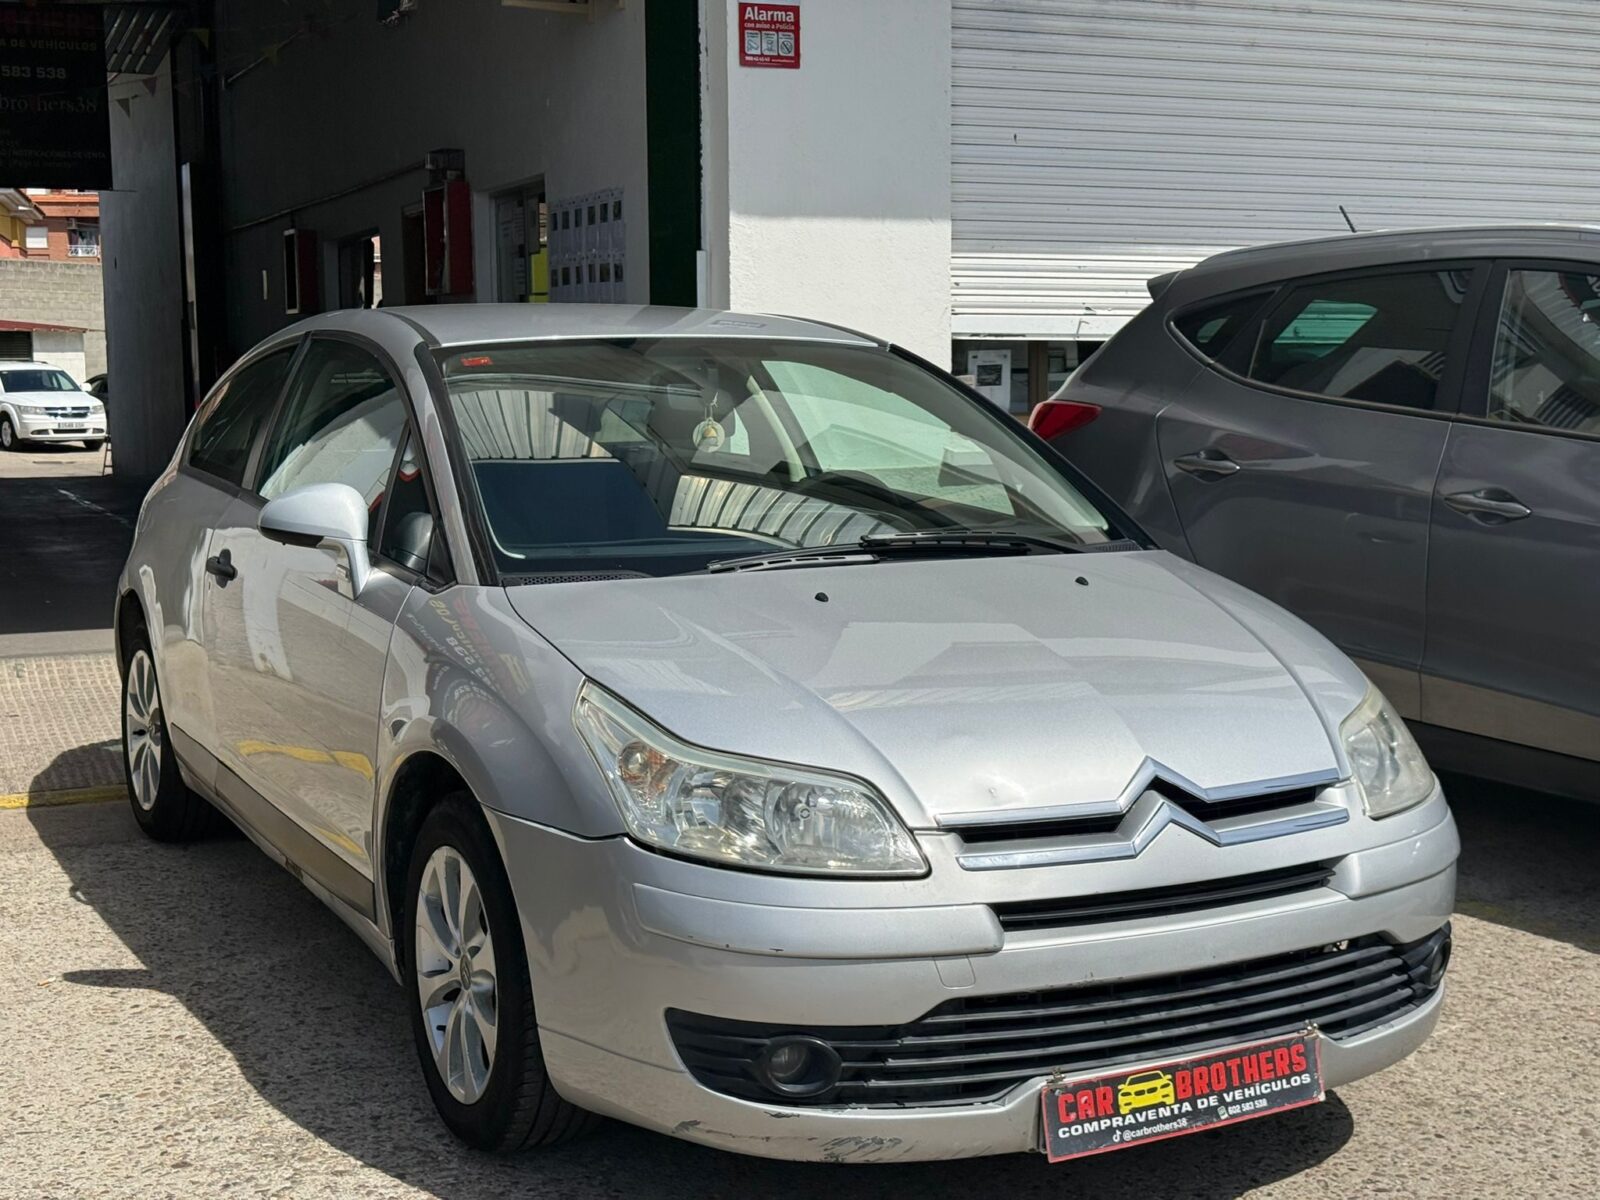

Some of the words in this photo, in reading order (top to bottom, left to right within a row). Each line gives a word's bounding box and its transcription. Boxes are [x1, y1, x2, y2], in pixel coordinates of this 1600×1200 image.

[744, 6, 794, 22] Alarma
[1, 65, 32, 78] 583
[36, 66, 67, 79] 538
[1057, 1086, 1115, 1123] CAR
[1175, 1043, 1307, 1099] BROTHERS
[1058, 1101, 1193, 1138] COMPRAVENTA
[1196, 1095, 1219, 1109] DE
[1223, 1073, 1312, 1102] VEHÍCULOS
[1228, 1104, 1241, 1115] 602
[1122, 1117, 1188, 1141] @carbrothers38
